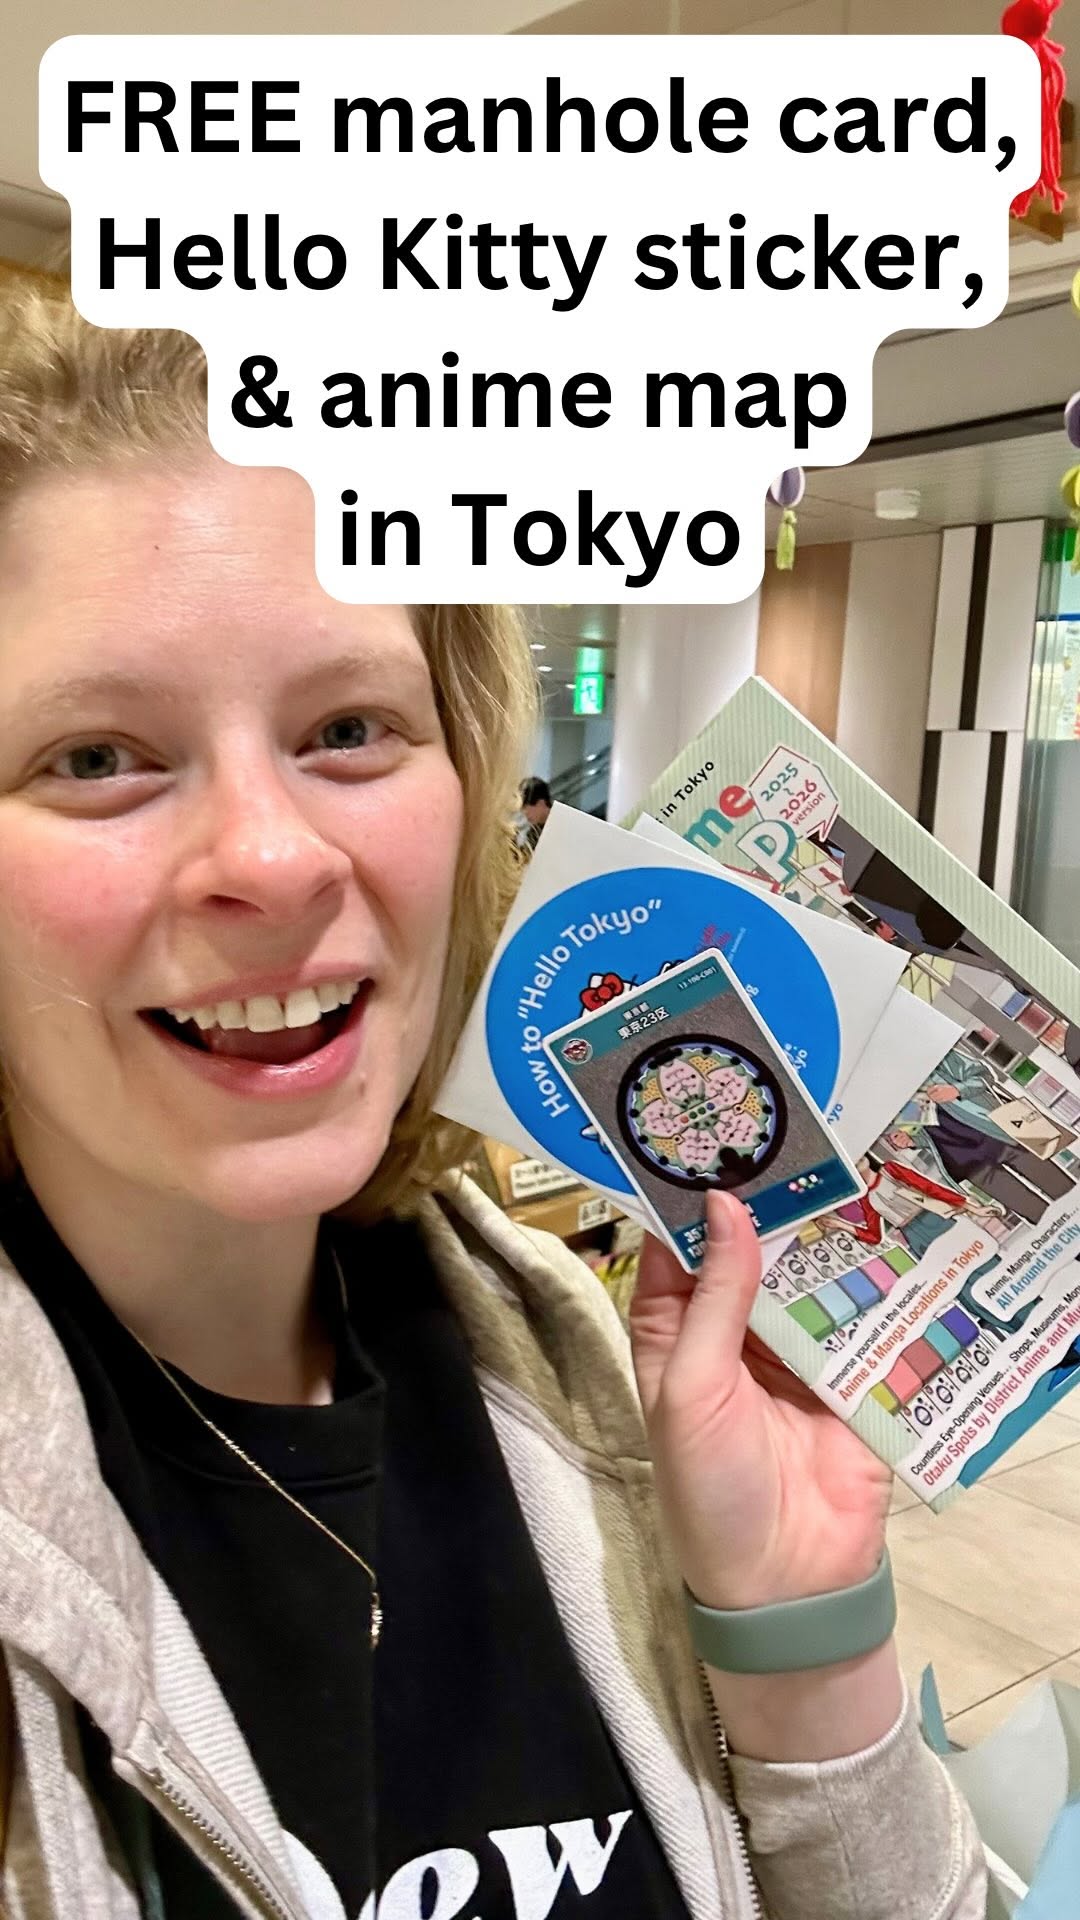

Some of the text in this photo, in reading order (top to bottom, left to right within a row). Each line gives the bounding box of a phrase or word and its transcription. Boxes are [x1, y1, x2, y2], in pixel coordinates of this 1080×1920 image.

[660, 761, 714, 818] in Tokyo
[760, 762, 799, 802] 2025
[779, 779, 818, 820] 2026
[792, 792, 826, 827] version
[683, 785, 755, 854] me
[560, 899, 662, 949] Tokyo"
[517, 945, 571, 1019] "Hello
[521, 1025, 543, 1054] to
[616, 1006, 670, 1040] 東京23区
[528, 1060, 570, 1118] How
[985, 1274, 1013, 1299] Anime,
[1006, 1249, 1037, 1276] Manga,
[996, 1291, 1015, 1311] All
[1010, 1257, 1047, 1296] Around
[1042, 1243, 1064, 1261] the
[838, 1239, 985, 1402] Anime & Manga Locations in Tokyo
[827, 1357, 858, 1391] Immerse
[854, 1322, 882, 1361] yourself
[880, 1319, 889, 1331] in
[886, 1308, 900, 1322] the
[910, 1440, 945, 1476] Countless
[940, 1396, 984, 1443] Eye-Opening
[1008, 1338, 1037, 1363] Shops,
[1030, 1303, 1069, 1339] Museums,
[922, 1453, 954, 1487] Otaku
[947, 1425, 979, 1458] Spots
[972, 1412, 992, 1430] by
[984, 1374, 1023, 1415] District
[1016, 1344, 1051, 1379] Anime
[1046, 1322, 1069, 1347] and
